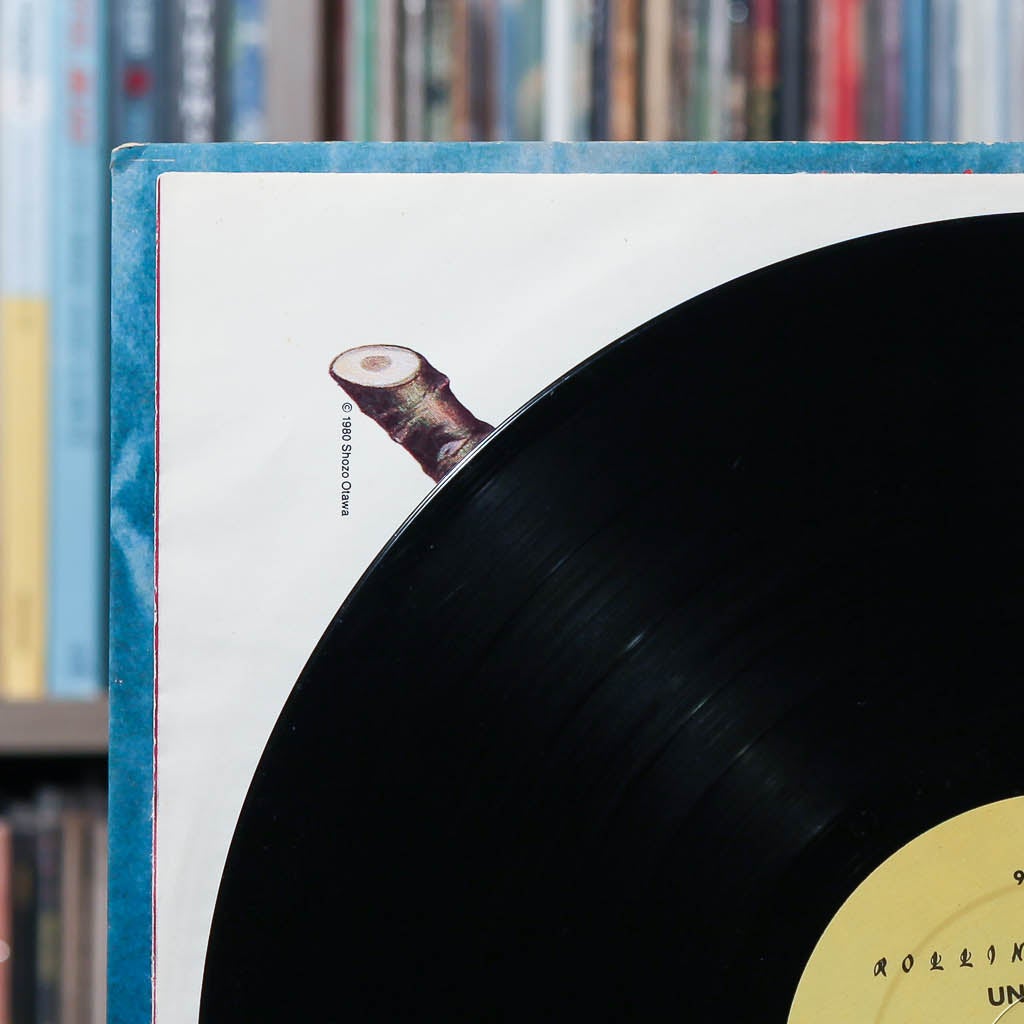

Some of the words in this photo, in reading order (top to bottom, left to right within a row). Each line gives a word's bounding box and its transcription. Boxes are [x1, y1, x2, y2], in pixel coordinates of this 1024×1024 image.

[342, 416, 352, 442] 1980
[342, 444, 352, 478] Shozo
[341, 480, 352, 516] Otawa
